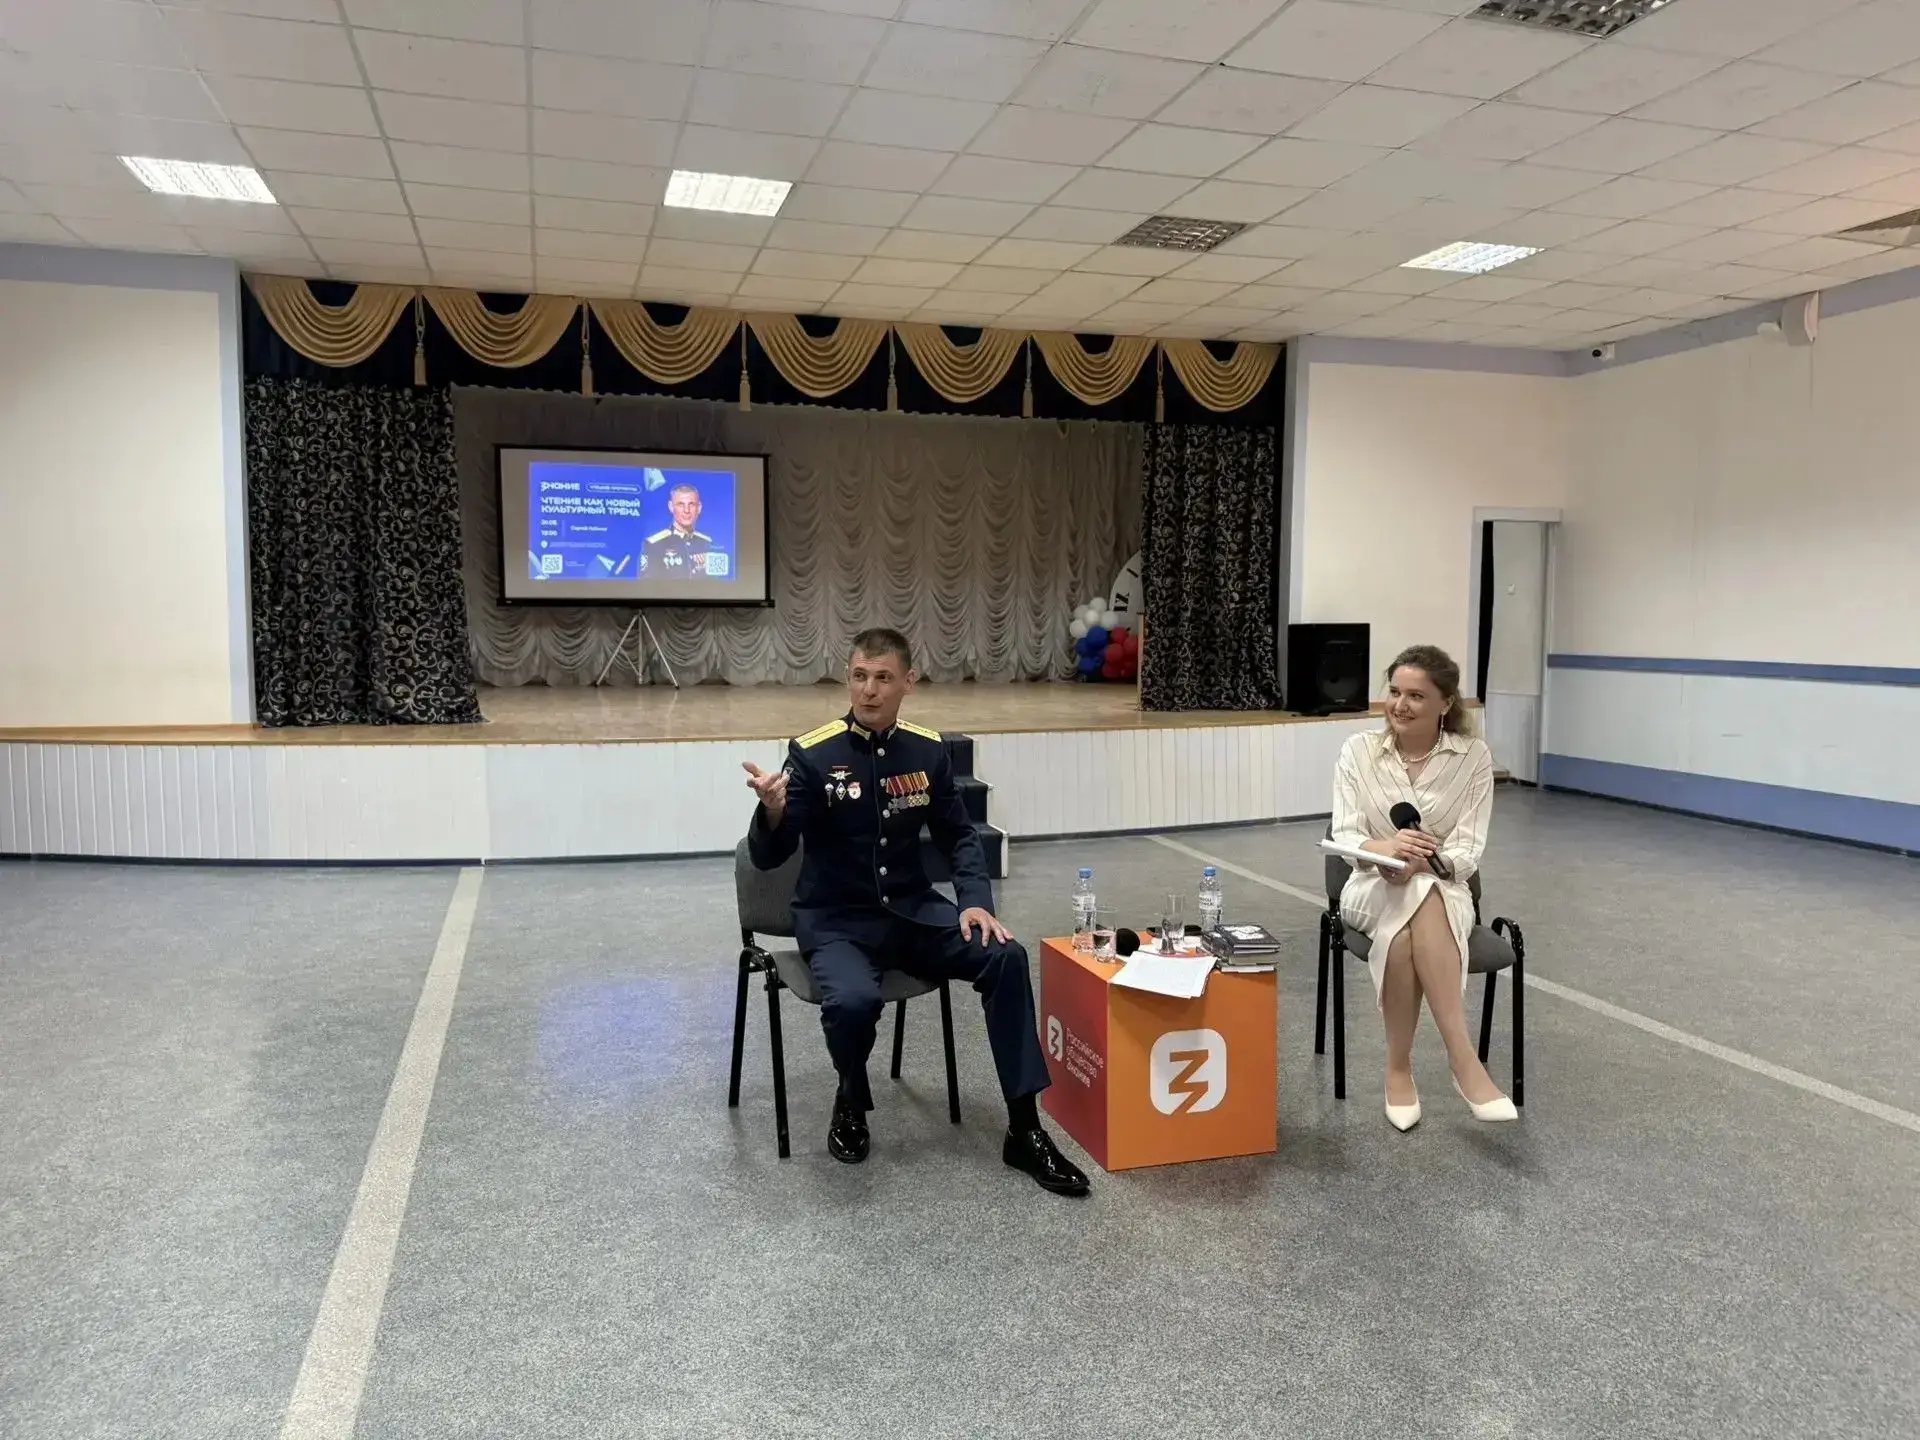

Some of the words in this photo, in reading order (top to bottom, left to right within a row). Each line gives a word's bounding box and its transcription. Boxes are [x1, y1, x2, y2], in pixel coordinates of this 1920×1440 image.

[541, 496, 581, 505] ЧТЕНИЕ
[583, 498, 603, 506] КАК
[605, 498, 640, 508] НОВЫЙ
[541, 505, 606, 515] КУЛЬТУРНЫЙ
[608, 507, 640, 516] ТРЕНД
